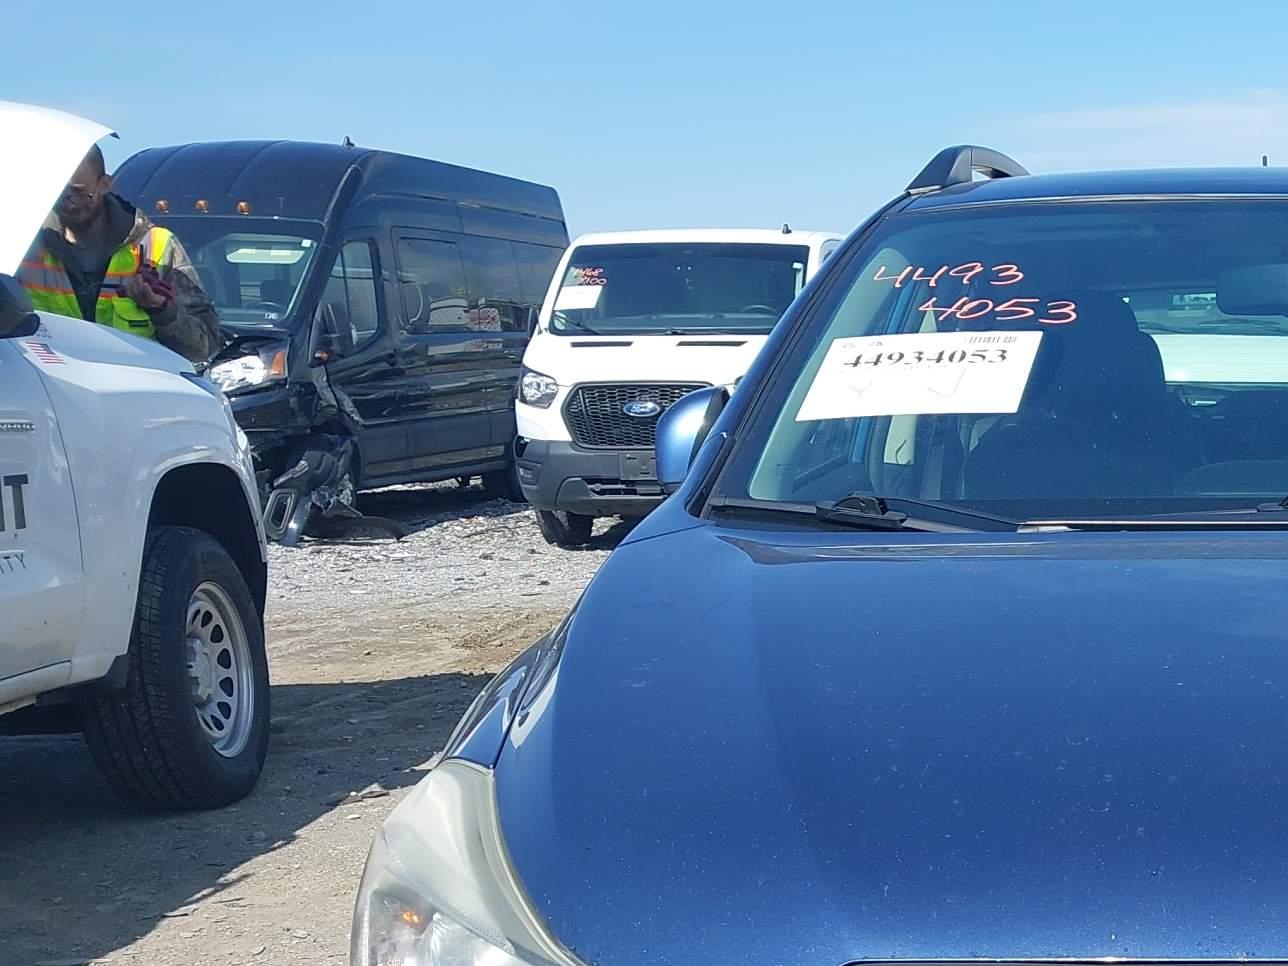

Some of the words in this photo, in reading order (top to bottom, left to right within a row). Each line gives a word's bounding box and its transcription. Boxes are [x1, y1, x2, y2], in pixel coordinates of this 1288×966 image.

[873, 262, 1024, 287] 4493
[918, 297, 1077, 324] 4053
[843, 349, 1008, 368] 44934053
